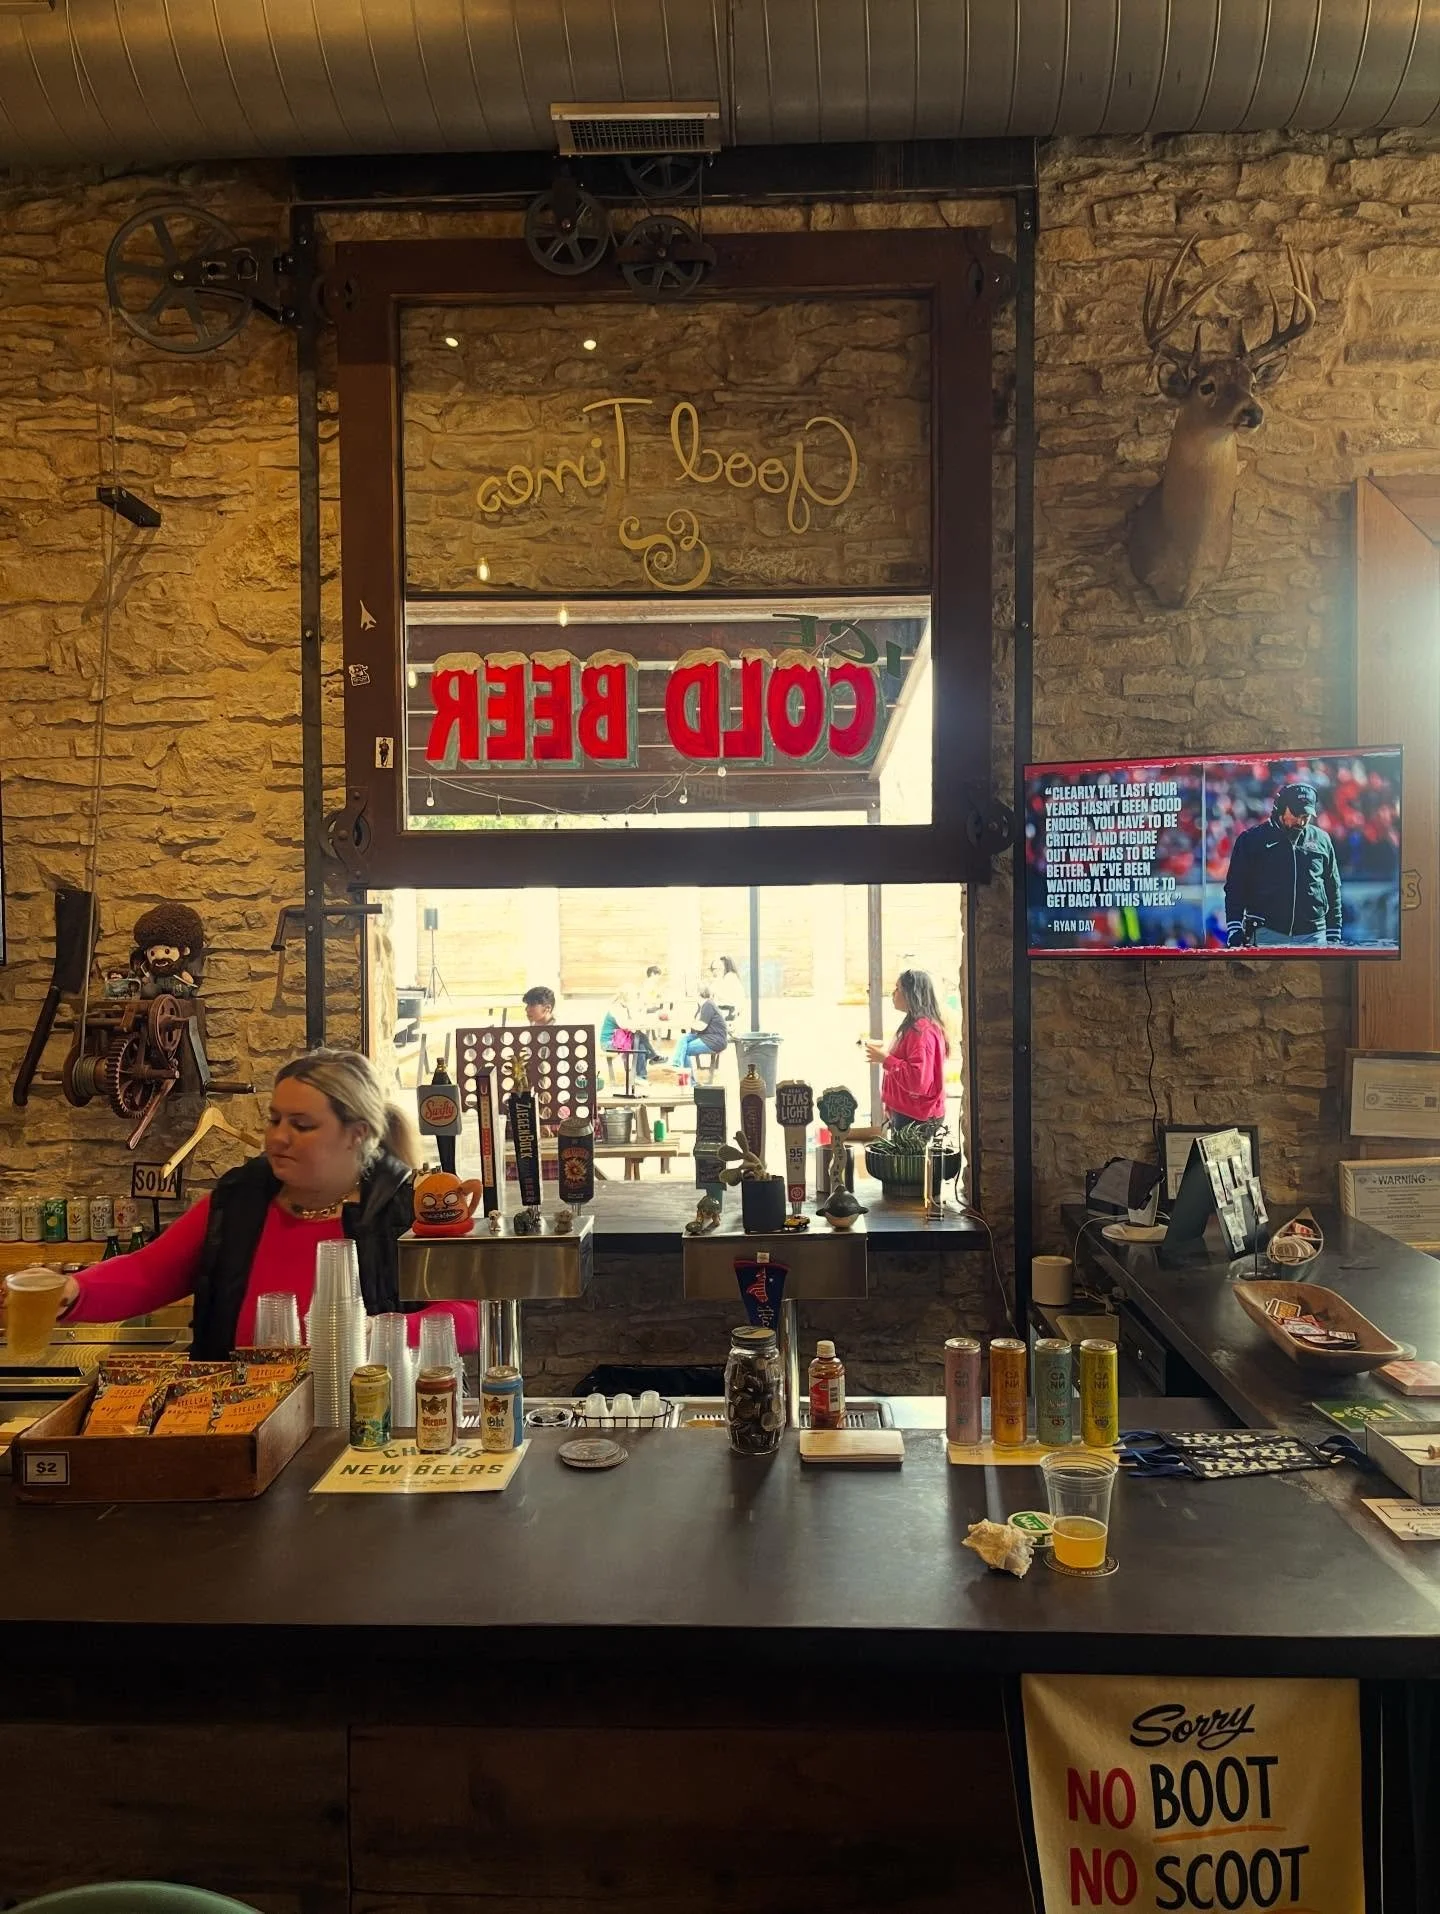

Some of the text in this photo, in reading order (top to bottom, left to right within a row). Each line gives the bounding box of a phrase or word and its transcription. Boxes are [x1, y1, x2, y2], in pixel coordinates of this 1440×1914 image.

[1098, 784, 1118, 799] THE
[1120, 783, 1147, 798] LAST
[1148, 782, 1178, 796] FOUR
[1045, 797, 1182, 816] YEARS HASN'T BEEN GOOD
[1045, 813, 1178, 832] ENOUGH. YOU HAVE TO BE
[1046, 830, 1157, 847] CRITICAL AND FIGURE
[1046, 846, 1156, 863] OUT WHAT HAS TO BE
[1046, 862, 1151, 878] BETTER. WE'VE BEEN
[1046, 877, 1176, 893] WAITING A LONG TIME TO
[1047, 893, 1066, 908] GET
[1068, 893, 1097, 907] BACK
[1099, 893, 1113, 907] TO
[1115, 892, 1140, 907] THIS
[1053, 920, 1077, 932] RYAN
[1078, 919, 1096, 932] DAY
[781, 1091, 809, 1106] TEXAS
[781, 1105, 809, 1121] LIGHT
[790, 1147, 803, 1158] 95
[1378, 1174, 1426, 1185] WARNING
[36, 1461, 57, 1474] $2
[340, 1464, 505, 1475] NEW BEERS
[1130, 1703, 1256, 1751] Sorry
[1067, 1755, 1279, 1830] NO BOOT
[1069, 1845, 1310, 1911] NO SCOOT
